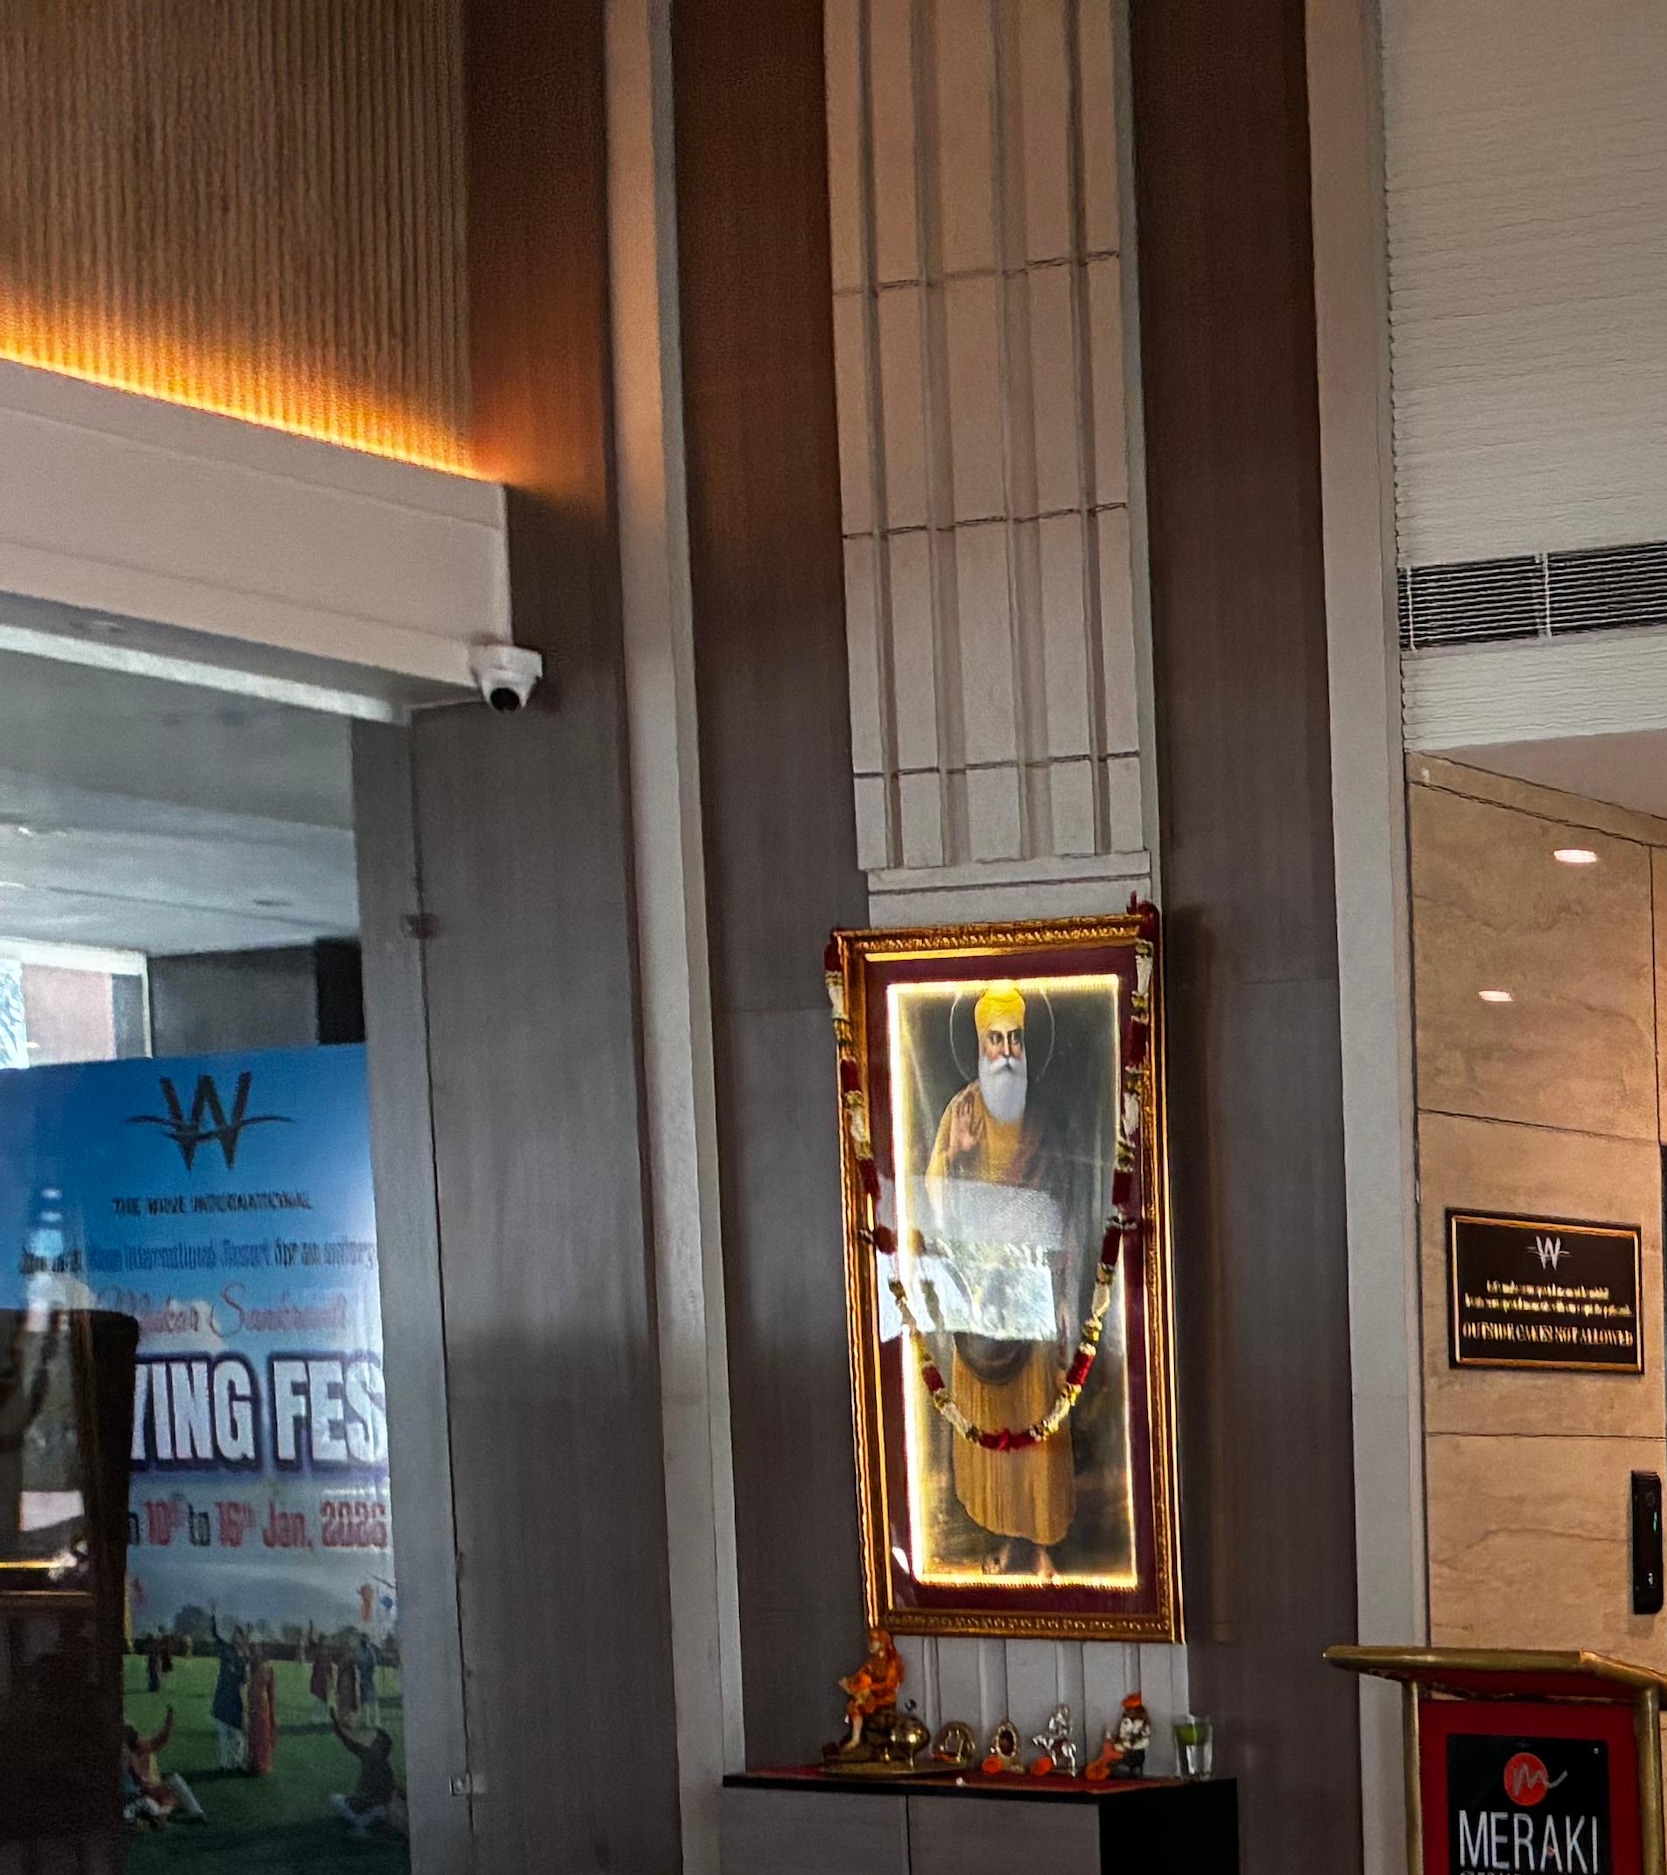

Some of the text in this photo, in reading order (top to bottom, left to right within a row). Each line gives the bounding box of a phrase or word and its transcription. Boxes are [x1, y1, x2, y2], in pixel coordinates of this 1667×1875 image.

[1462, 1321, 1634, 1348] OUTSIDE CAKES NOT ALLOWED
[130, 1360, 388, 1463] YING FES
[1458, 1810, 1599, 1875] MERAKI
